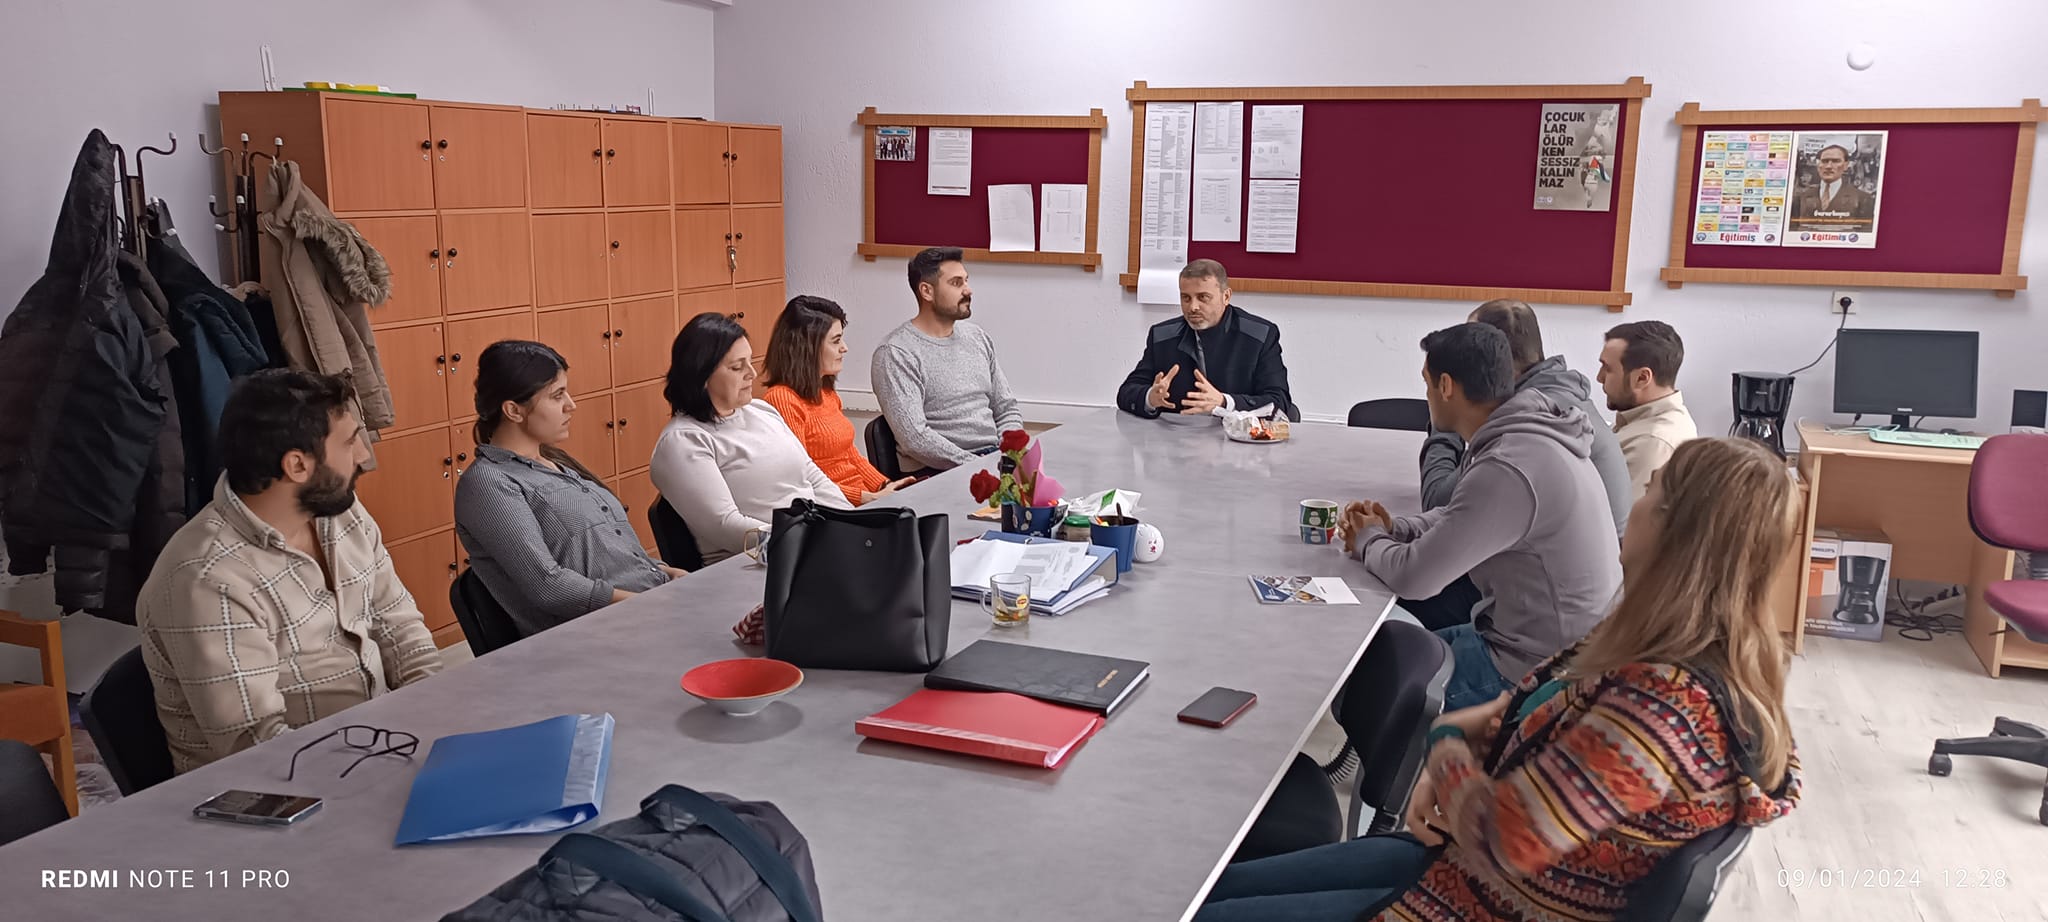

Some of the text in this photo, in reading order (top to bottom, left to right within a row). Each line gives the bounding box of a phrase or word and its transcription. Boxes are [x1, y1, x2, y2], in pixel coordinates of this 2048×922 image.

[1545, 112, 1585, 123] ÇOCUK
[1543, 124, 1567, 133] LAR
[1543, 134, 1574, 146] ÖLÜR
[1541, 147, 1565, 156] KEN
[1540, 168, 1575, 177] KALIN
[1539, 178, 1564, 188] MAZ
